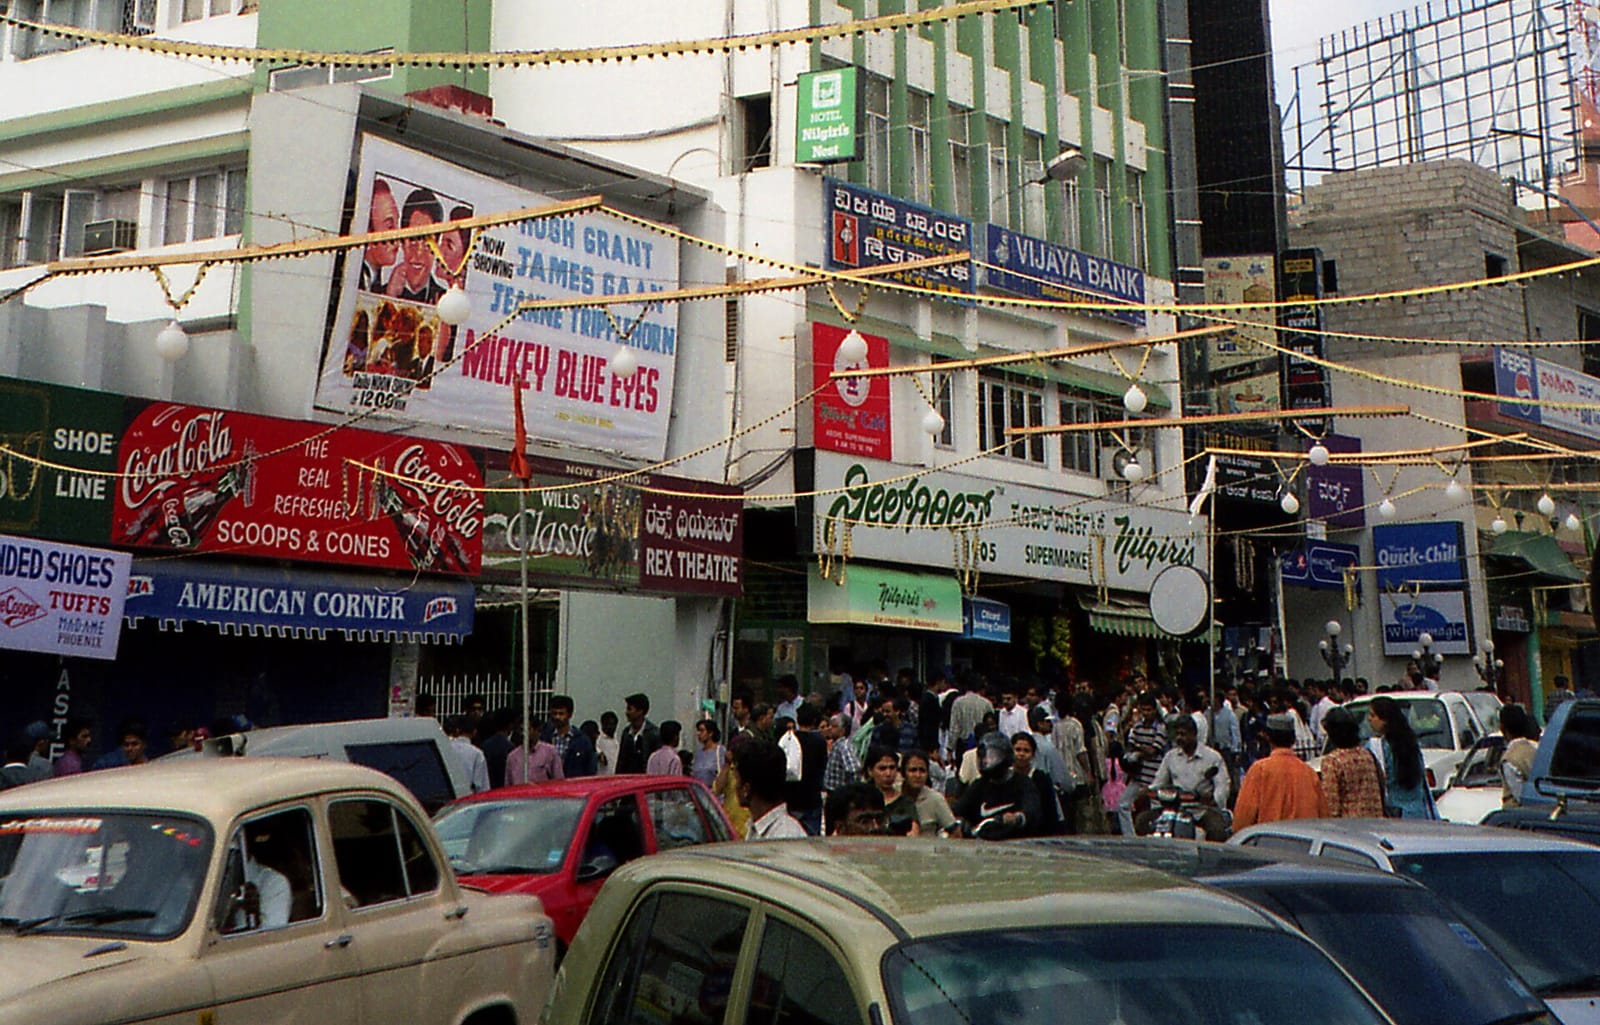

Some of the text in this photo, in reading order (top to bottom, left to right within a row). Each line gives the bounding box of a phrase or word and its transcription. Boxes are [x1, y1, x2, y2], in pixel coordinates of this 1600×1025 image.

[812, 144, 839, 158] Nest
[483, 235, 505, 252] NOW
[584, 226, 653, 270] GRANT
[474, 253, 514, 279] SHOWING
[517, 246, 594, 295] JAMES
[1015, 236, 1082, 281] VIJAYA
[1088, 258, 1139, 298] BANK
[461, 329, 660, 414] MICKEY BLUE EYES
[54, 428, 113, 454] SHOE
[305, 440, 329, 459] THE
[122, 411, 233, 509] Coca-Cola
[566, 464, 594, 477] NOW
[55, 475, 107, 499] LINE
[298, 467, 330, 488] REAL
[394, 444, 483, 540] Coca-Cola
[541, 490, 580, 510] WILLS
[217, 519, 390, 558] SCOOPS & CONES
[506, 509, 597, 557] Classic
[646, 547, 739, 583] REX THEATRE
[1025, 544, 1089, 571] SUPERMARKE
[1378, 543, 1458, 567] Quick-Chill
[45, 551, 115, 589] SHOES
[49, 591, 111, 616] TUFFS
[178, 581, 405, 620] AMERICAN CORNER
[1387, 623, 1464, 640] Whitmagic
